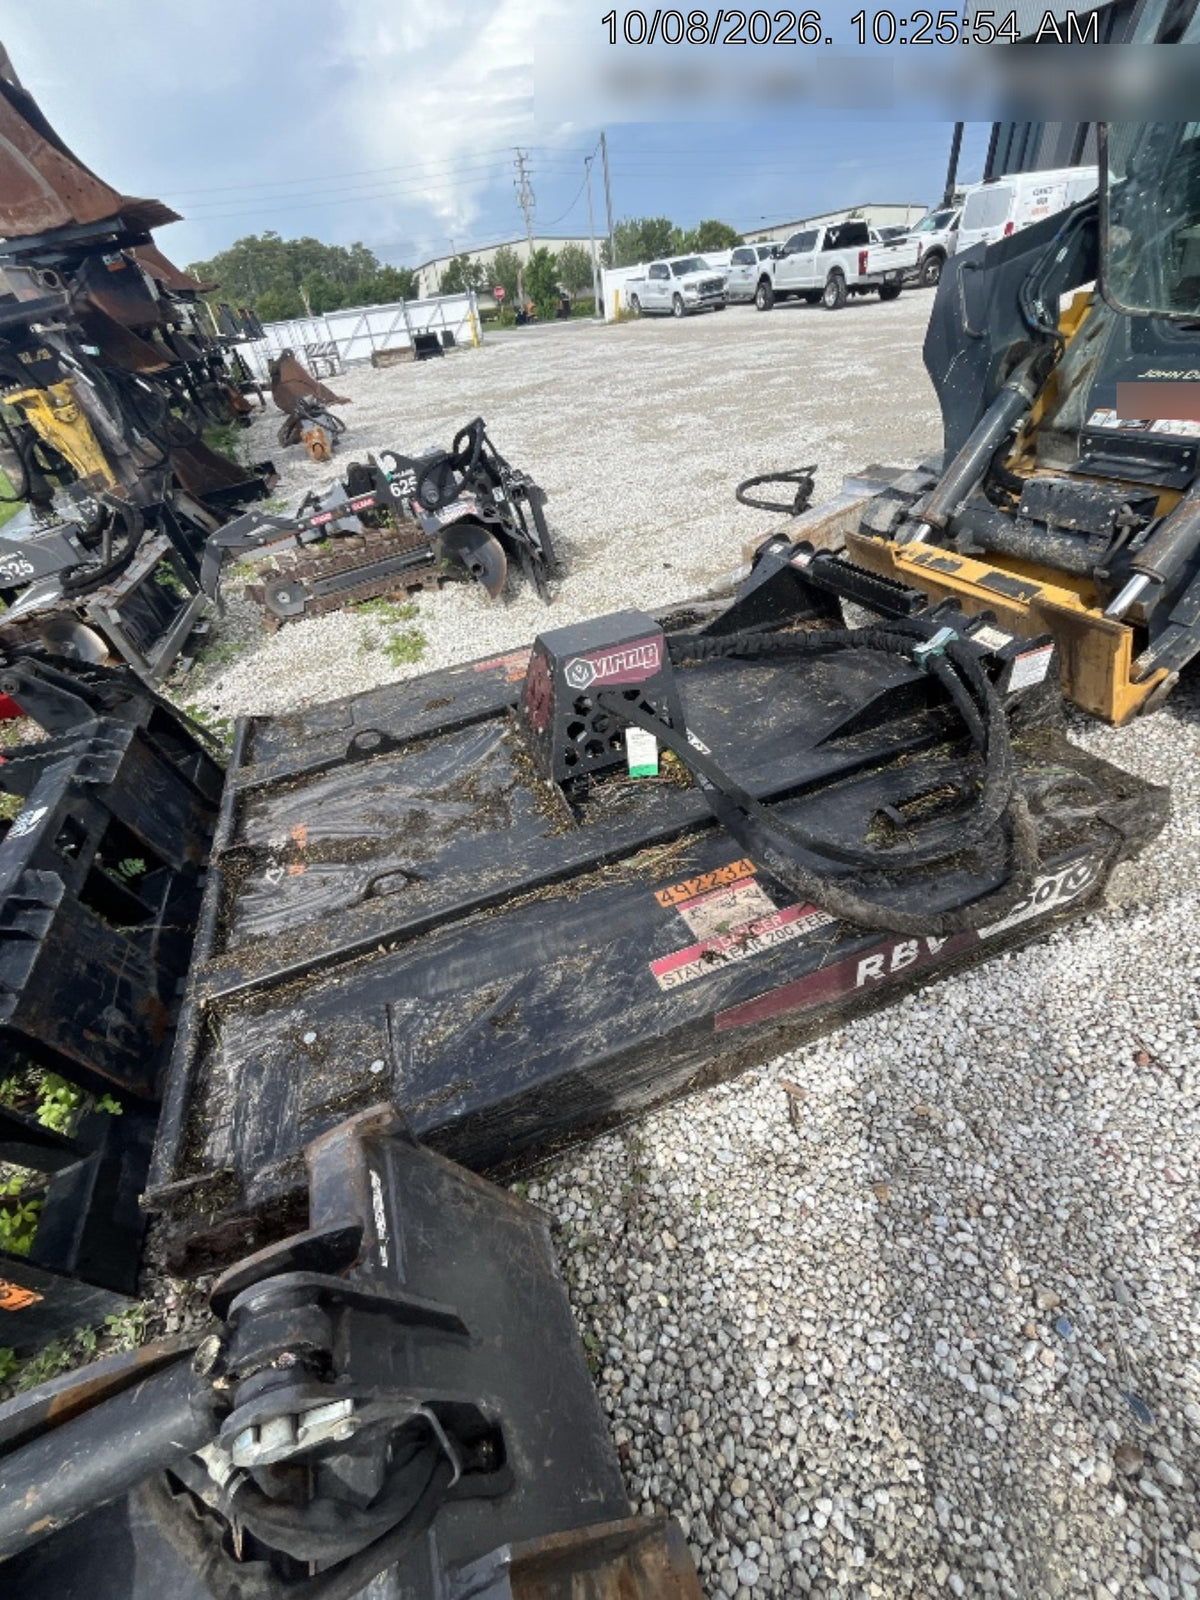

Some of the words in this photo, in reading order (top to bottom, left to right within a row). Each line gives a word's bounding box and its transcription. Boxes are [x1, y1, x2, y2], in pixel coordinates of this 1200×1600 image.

[391, 475, 418, 497] 625
[662, 860, 751, 902] 492234
[663, 959, 703, 986] STAY
[796, 911, 829, 930] FEE
